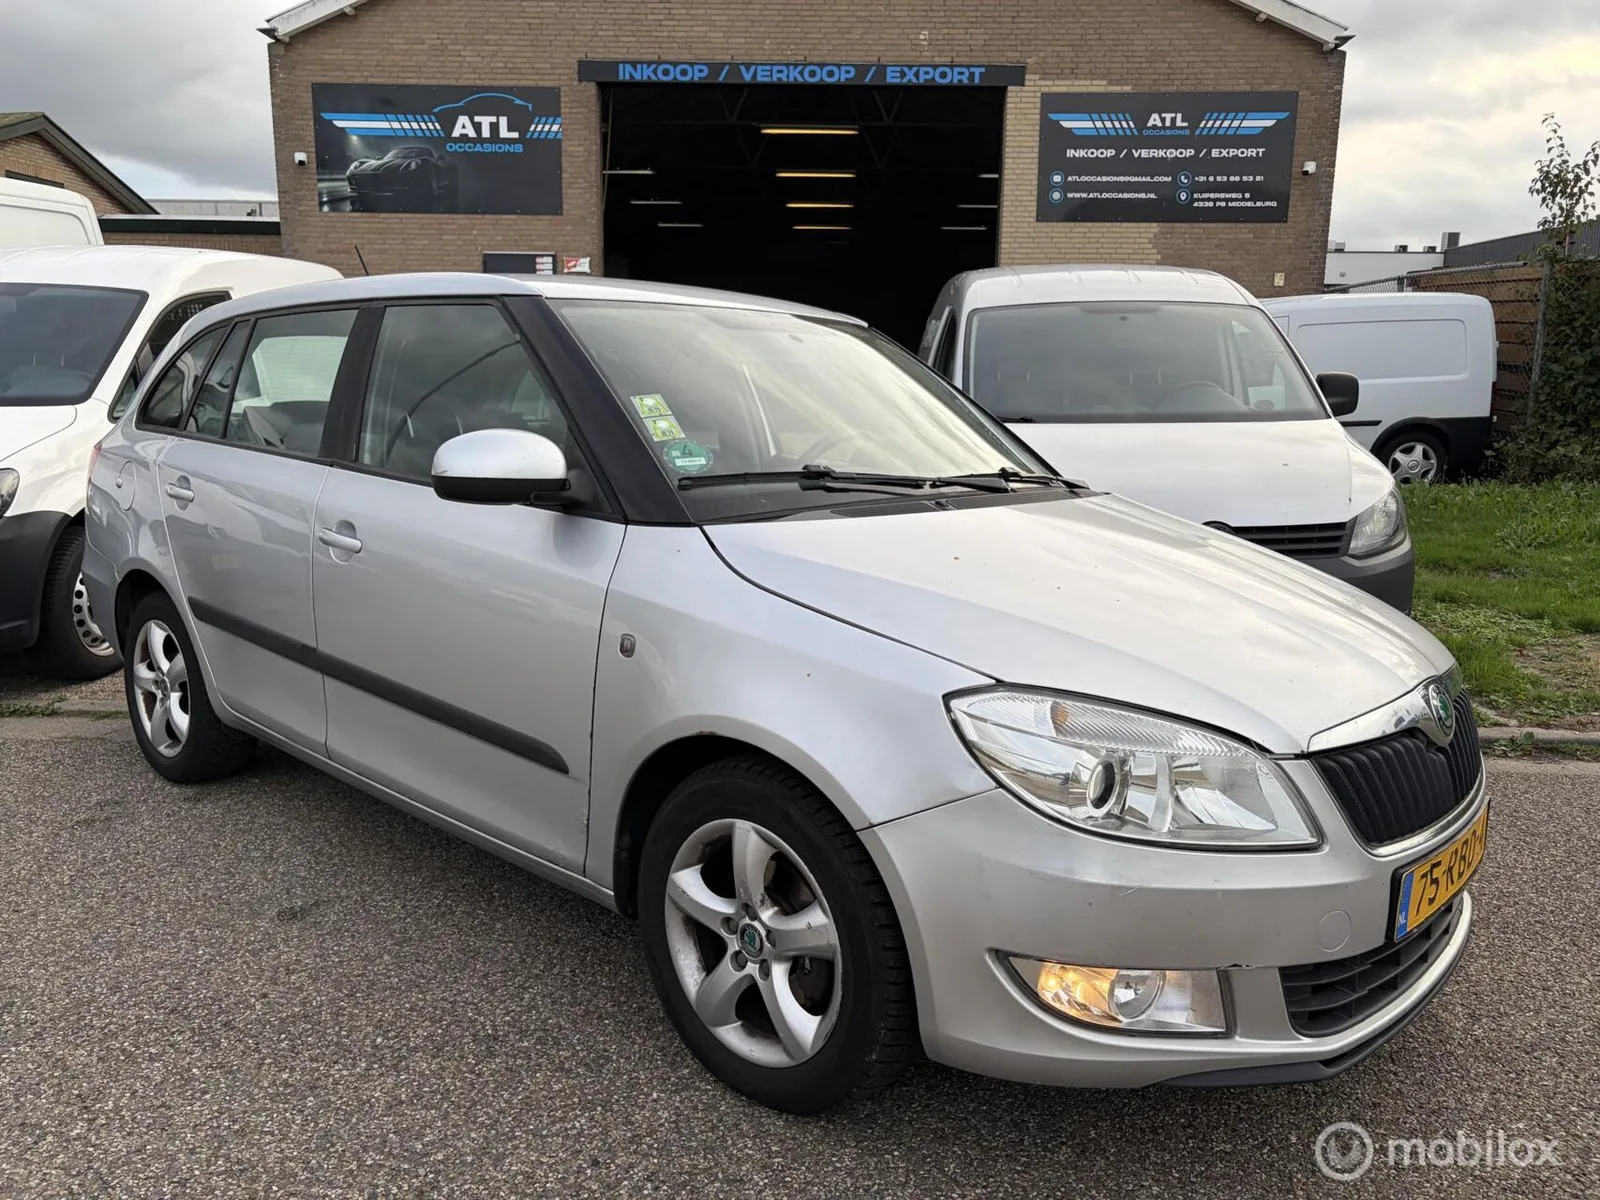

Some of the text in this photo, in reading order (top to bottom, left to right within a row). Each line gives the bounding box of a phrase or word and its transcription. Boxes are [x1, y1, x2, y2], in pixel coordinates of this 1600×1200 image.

[618, 63, 985, 84] INKOOP / VERKOOP / EXPORT
[451, 115, 520, 139] ATL
[1146, 113, 1189, 127] ATL
[446, 142, 524, 153] OCCASIONS
[1066, 148, 1266, 158] INKOOP / VERKOOP / EXPORT
